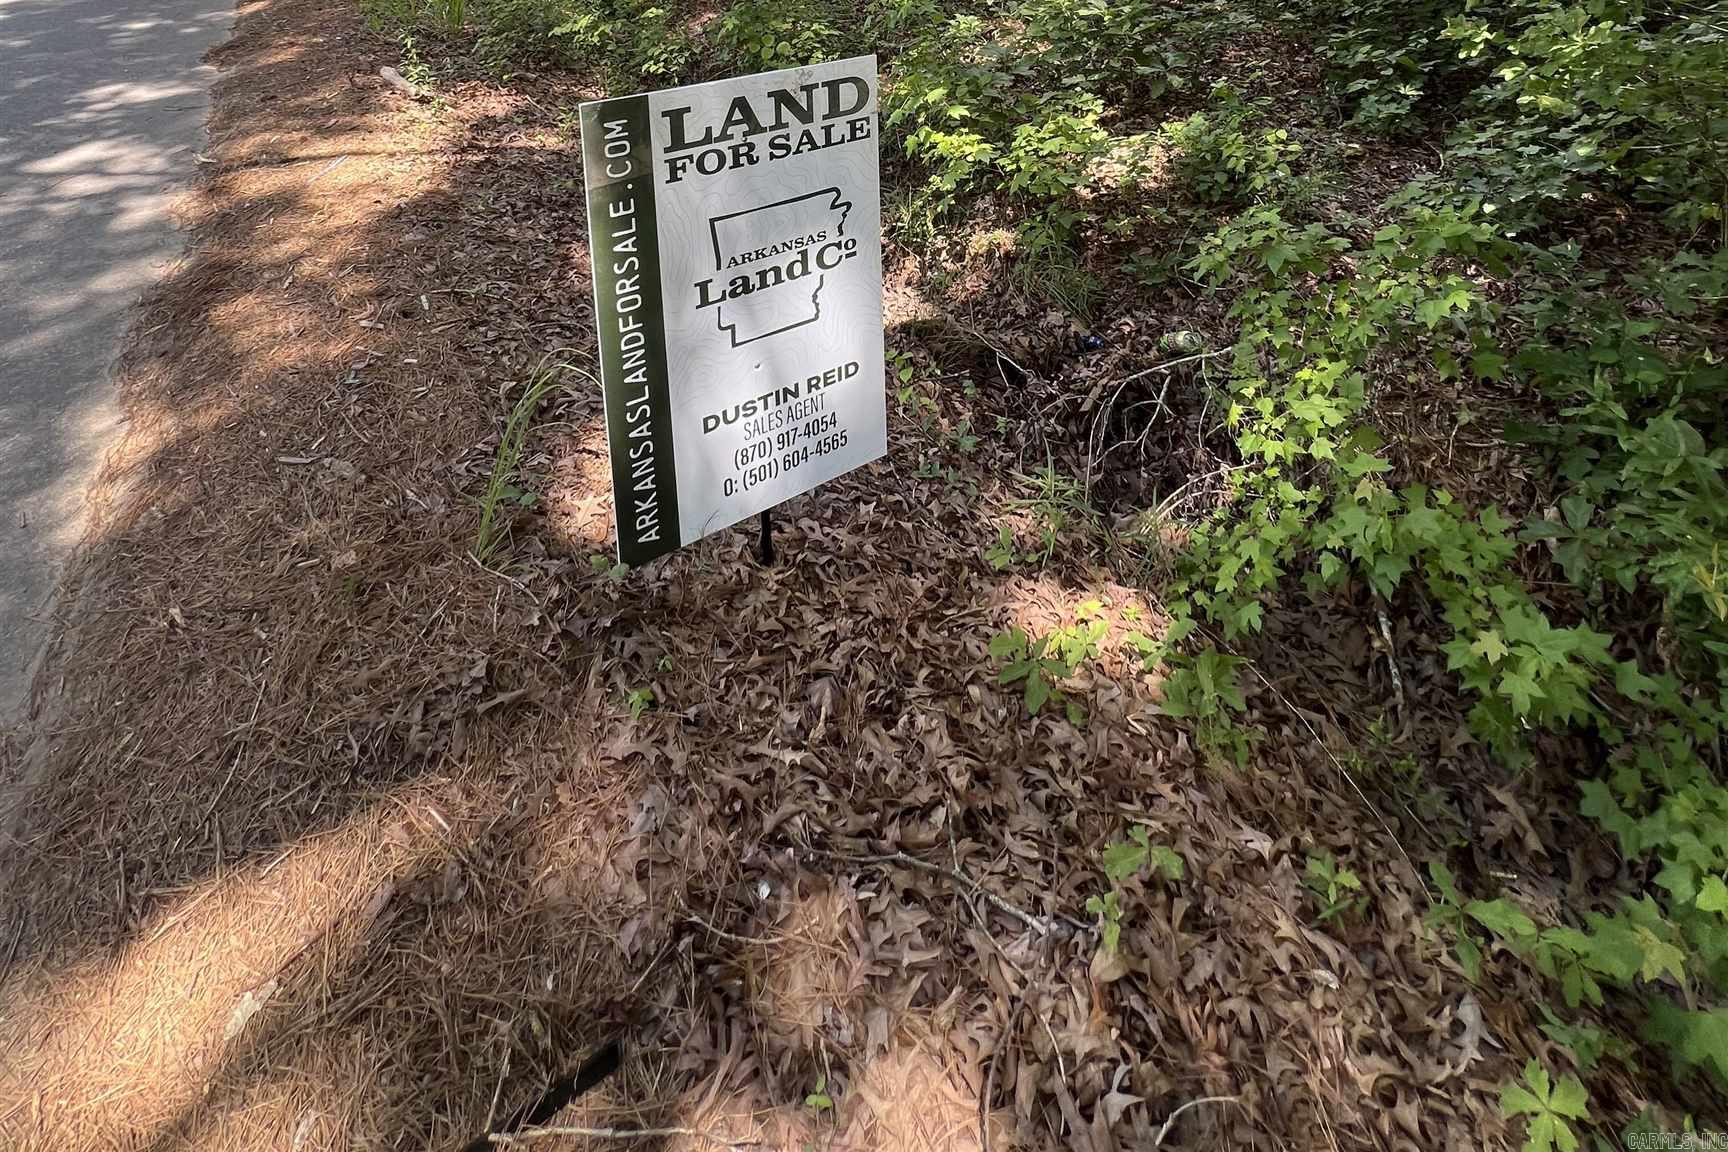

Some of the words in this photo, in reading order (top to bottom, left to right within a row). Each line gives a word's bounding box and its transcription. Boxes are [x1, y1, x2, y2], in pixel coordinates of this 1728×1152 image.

[661, 76, 870, 154] LAND
[665, 143, 759, 184] FOR
[768, 117, 871, 161] SALE
[726, 231, 827, 269] ARKANSAS
[604, 119, 660, 544] ARKANSASLANDFORSALE.COM
[703, 382, 800, 434] DUSTIN
[807, 361, 860, 394] REID
[744, 410, 783, 440] SALES
[786, 392, 826, 421] AGENT
[734, 437, 773, 470] (870)
[777, 412, 838, 452] 917-4054
[743, 465, 779, 491] (501)
[783, 430, 849, 473] 604-4565
